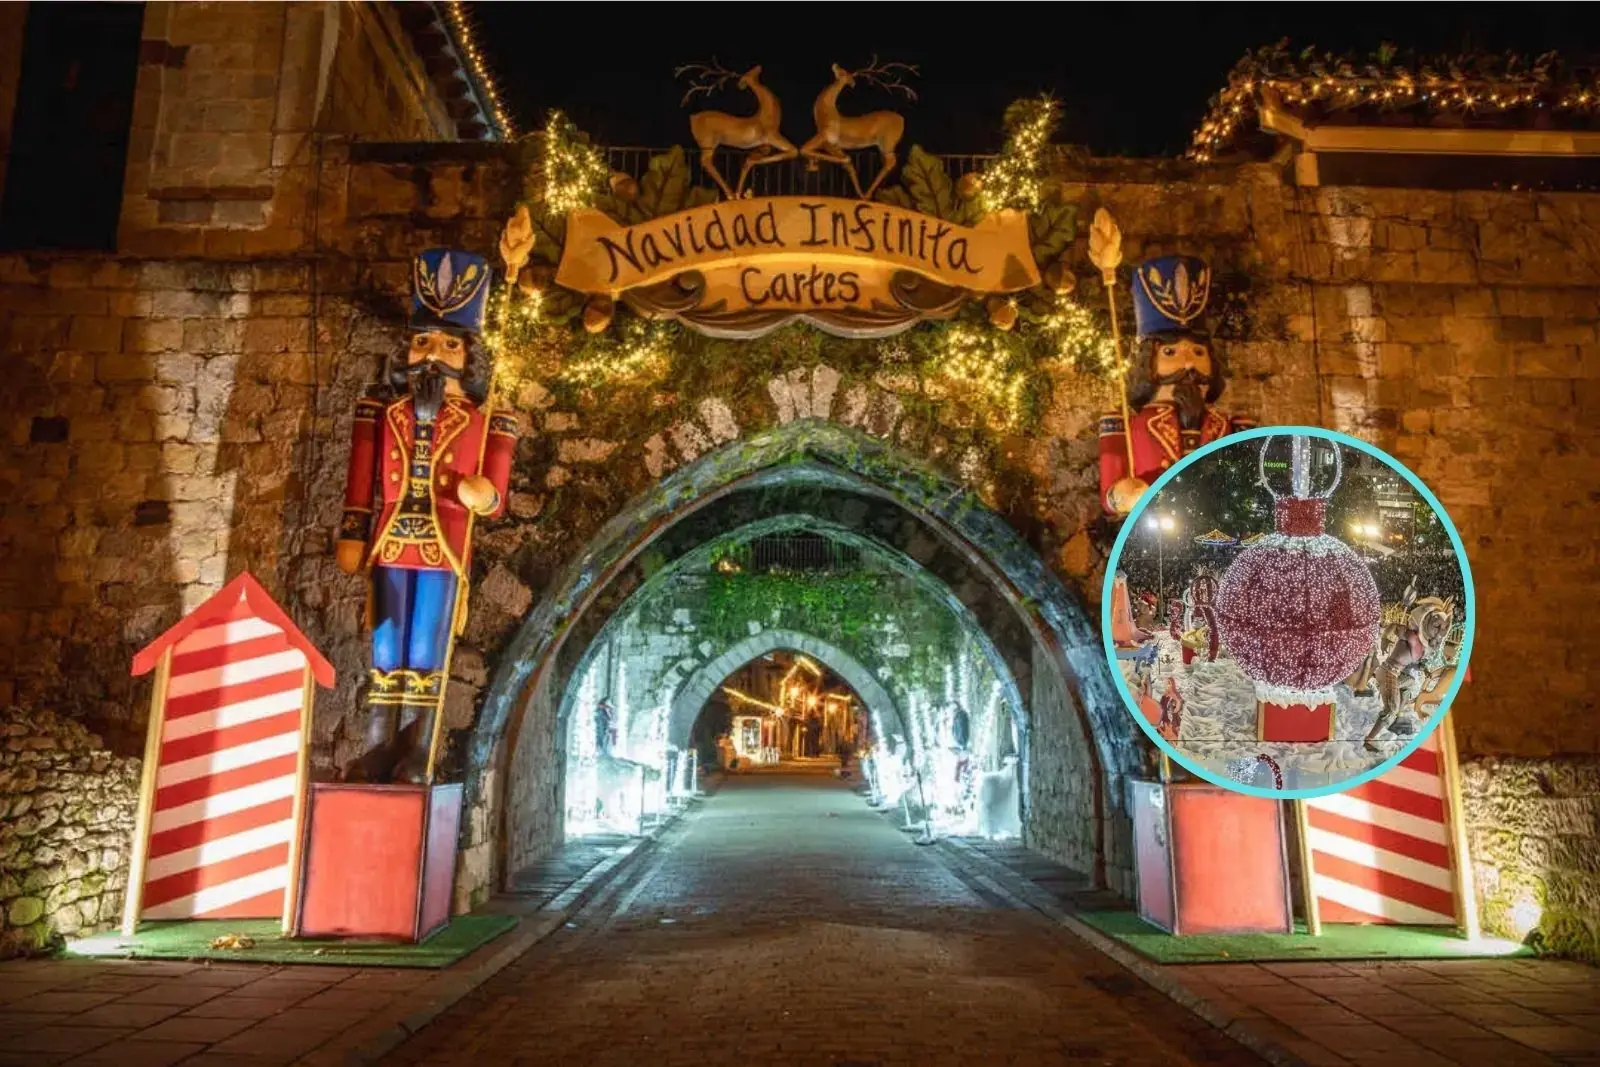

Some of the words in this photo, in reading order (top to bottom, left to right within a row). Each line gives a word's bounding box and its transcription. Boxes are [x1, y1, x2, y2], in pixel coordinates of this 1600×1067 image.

[596, 202, 785, 283] Navidad
[799, 203, 984, 274] Infinita
[741, 263, 861, 305] Cartes
